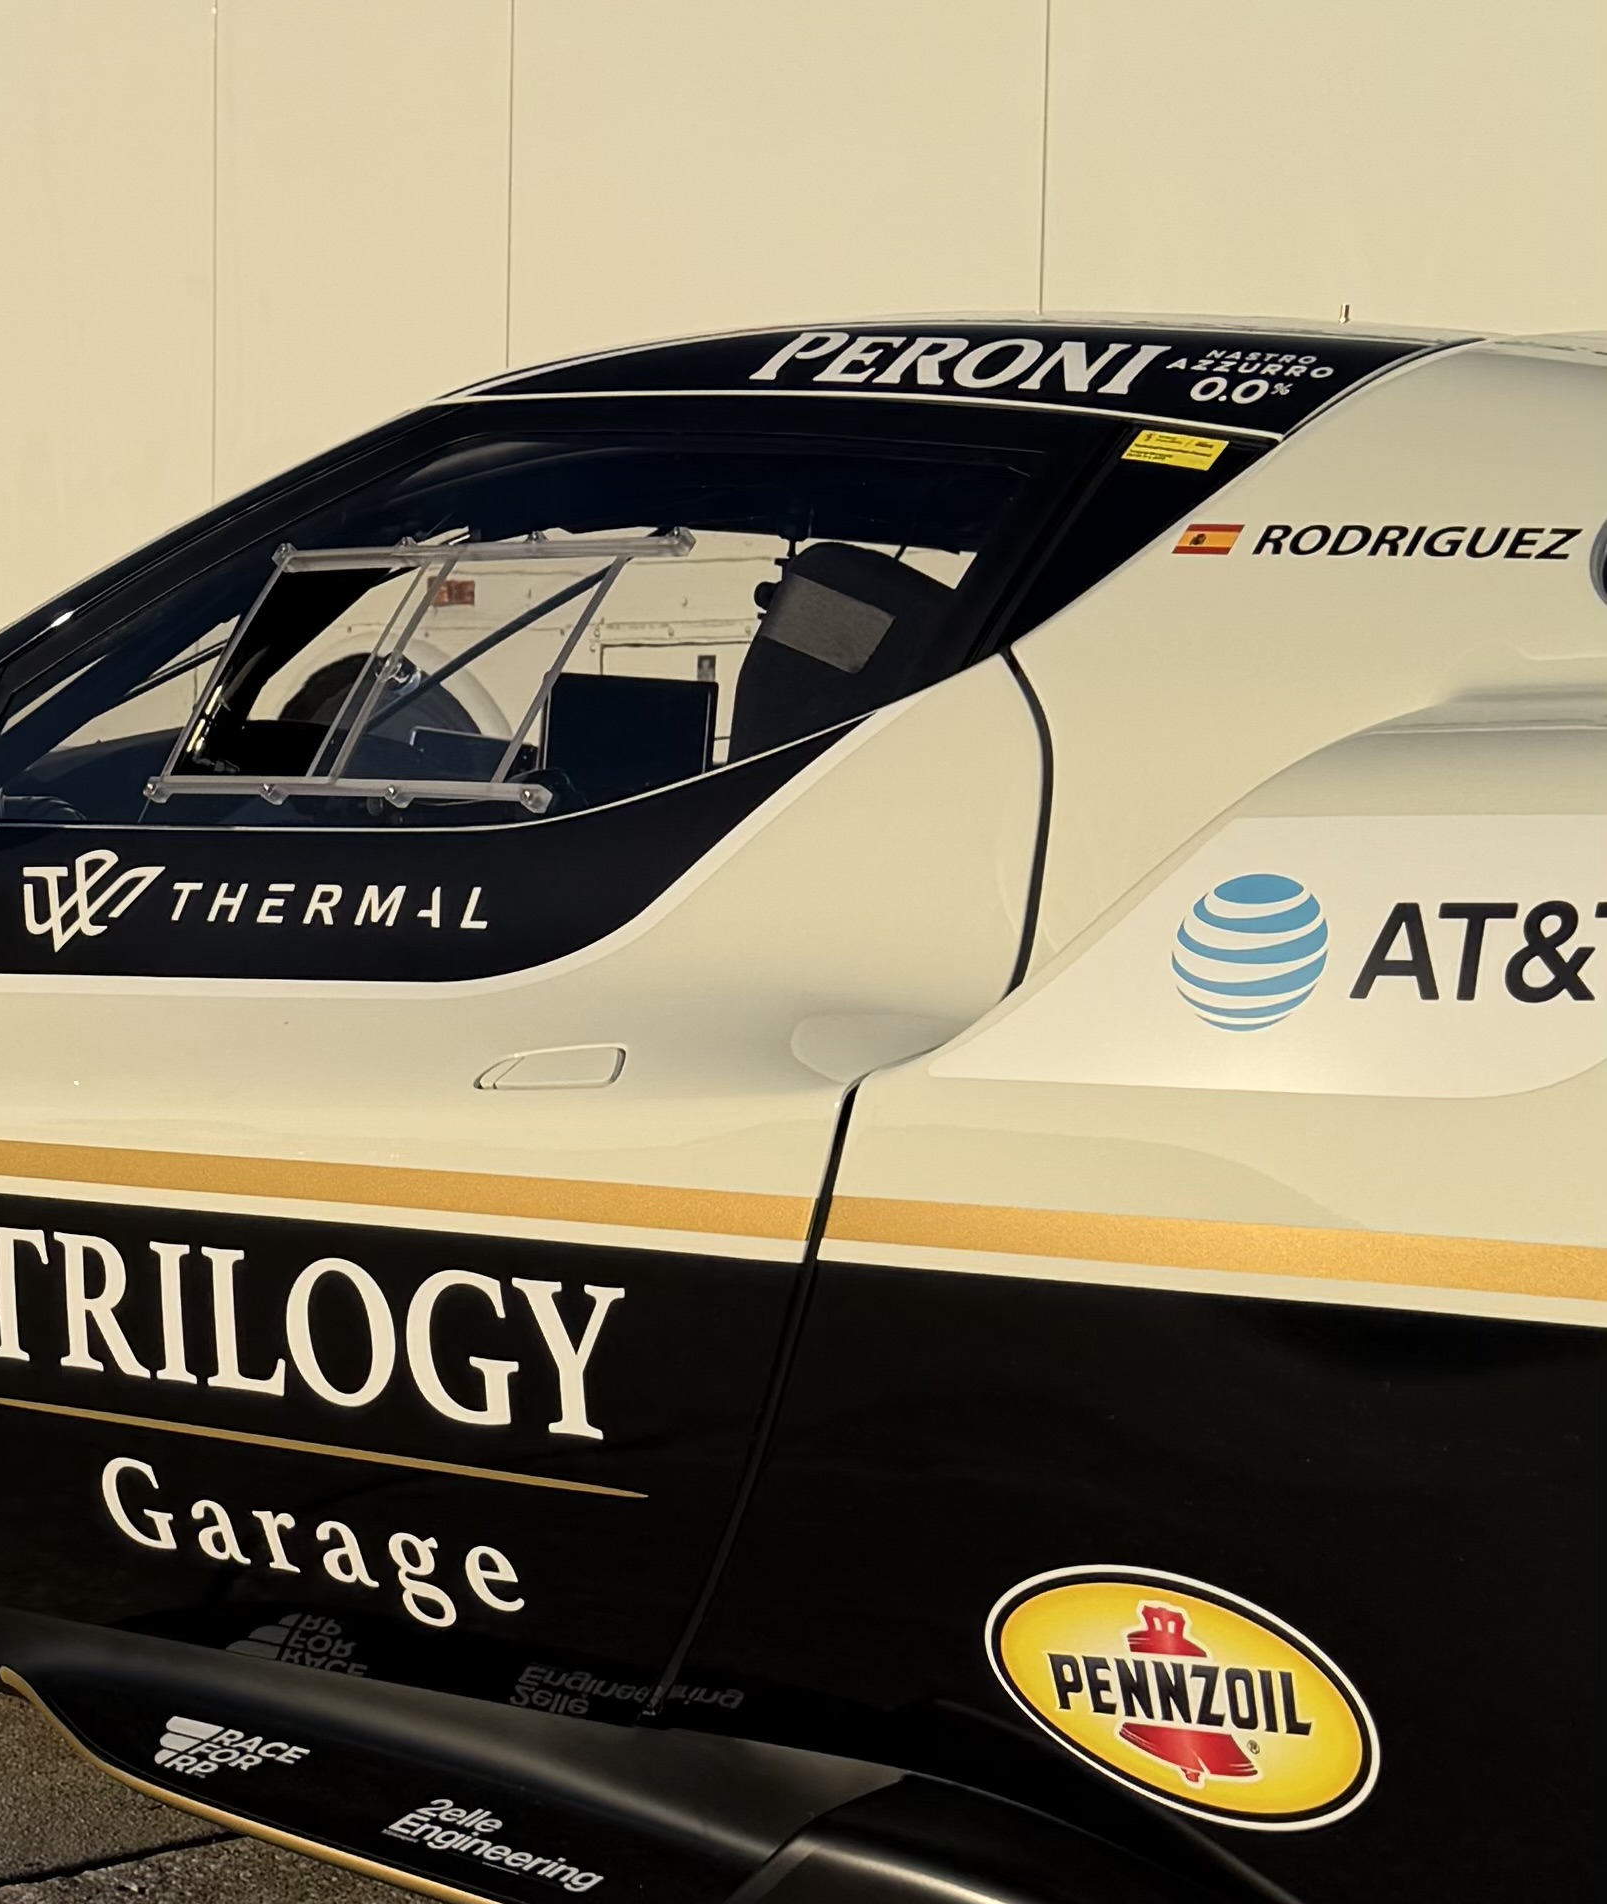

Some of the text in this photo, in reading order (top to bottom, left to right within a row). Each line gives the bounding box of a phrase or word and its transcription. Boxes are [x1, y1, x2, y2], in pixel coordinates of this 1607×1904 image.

[749, 331, 1171, 396] PERONI
[1165, 357, 1335, 379] AZZURRO
[1206, 349, 1317, 365] NASTRO
[1251, 523, 1585, 561] RODRIGUEZ
[169, 882, 490, 930] THERMAL
[1349, 900, 1607, 1003] AT&
[102, 1456, 526, 1629] Garage
[1047, 1652, 1313, 1736] PENNZOIL
[164, 1754, 219, 1774] RP
[188, 1742, 263, 1771] FOR
[210, 1728, 311, 1765] RACE
[415, 1798, 503, 1833] 2elle
[388, 1812, 605, 1893] Engineering
